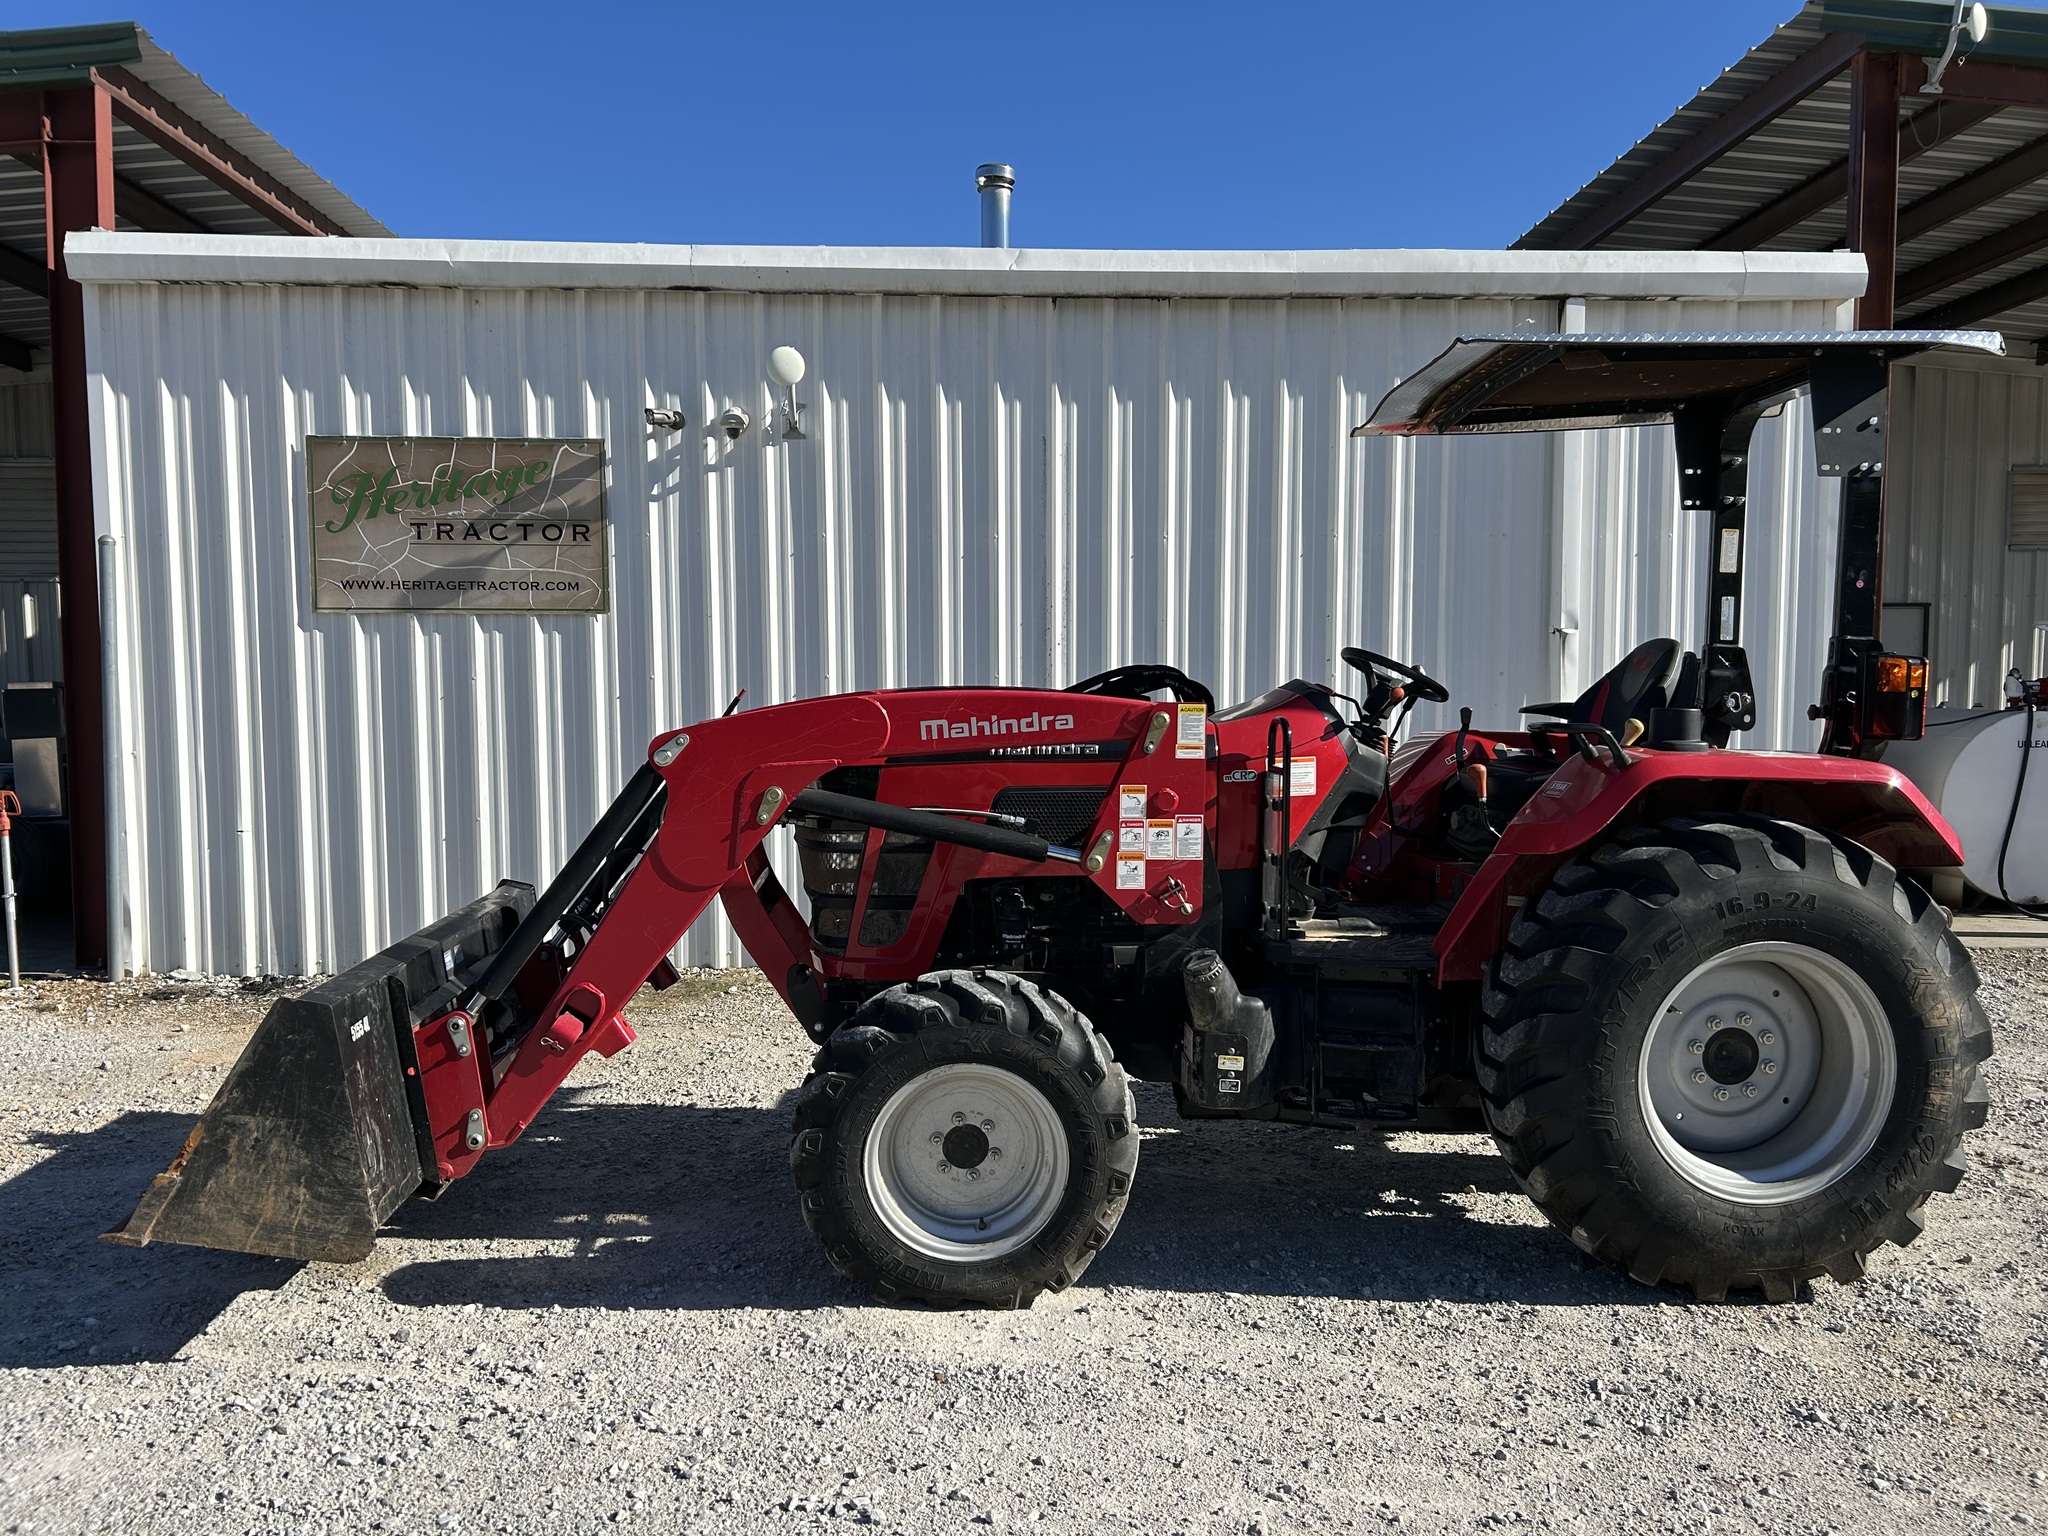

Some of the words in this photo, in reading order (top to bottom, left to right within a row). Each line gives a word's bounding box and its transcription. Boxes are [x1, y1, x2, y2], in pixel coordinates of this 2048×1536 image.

[325, 459, 549, 534] Heritage
[410, 522, 591, 542] TRACTOR
[340, 579, 580, 592] WWW.HERITAGETRACTOR.COM
[919, 711, 1074, 741] Mahindra
[2017, 740, 2048, 748] ULEA
[1711, 891, 1818, 920] 16.9-24
[1723, 918, 1808, 937] INDUSTRIAL
